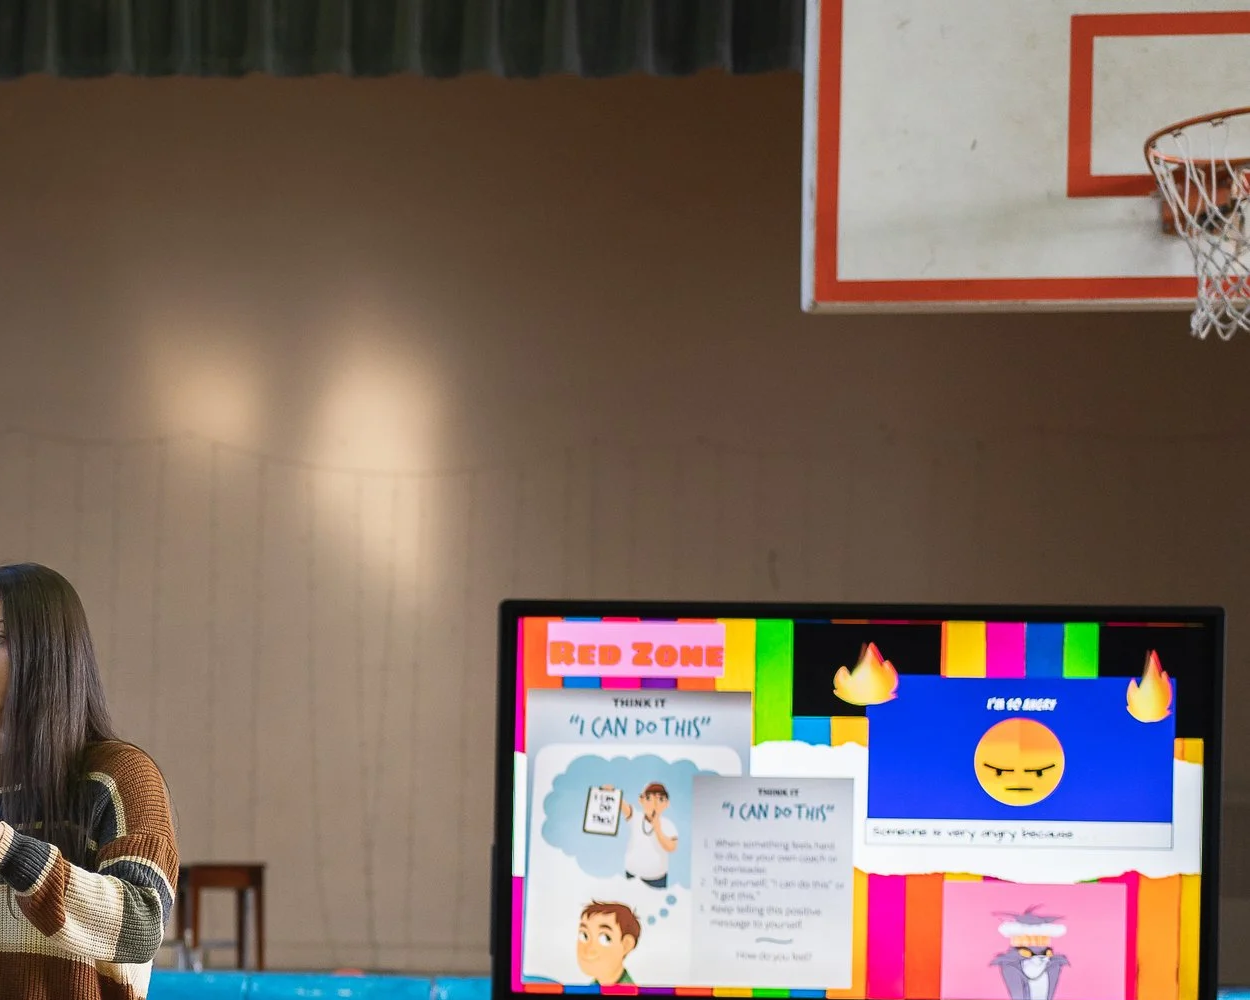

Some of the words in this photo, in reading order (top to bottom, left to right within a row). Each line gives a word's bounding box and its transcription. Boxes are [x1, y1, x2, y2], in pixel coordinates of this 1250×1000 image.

[549, 640, 622, 666] RED
[631, 642, 725, 667] ZONE
[613, 698, 651, 708] THINK
[654, 698, 667, 708] IT
[591, 716, 628, 739] CAN
[635, 719, 657, 736] DO
[757, 787, 788, 797] THINK
[790, 788, 799, 797] IT
[739, 803, 768, 821] CAN
[775, 804, 792, 819] DO
